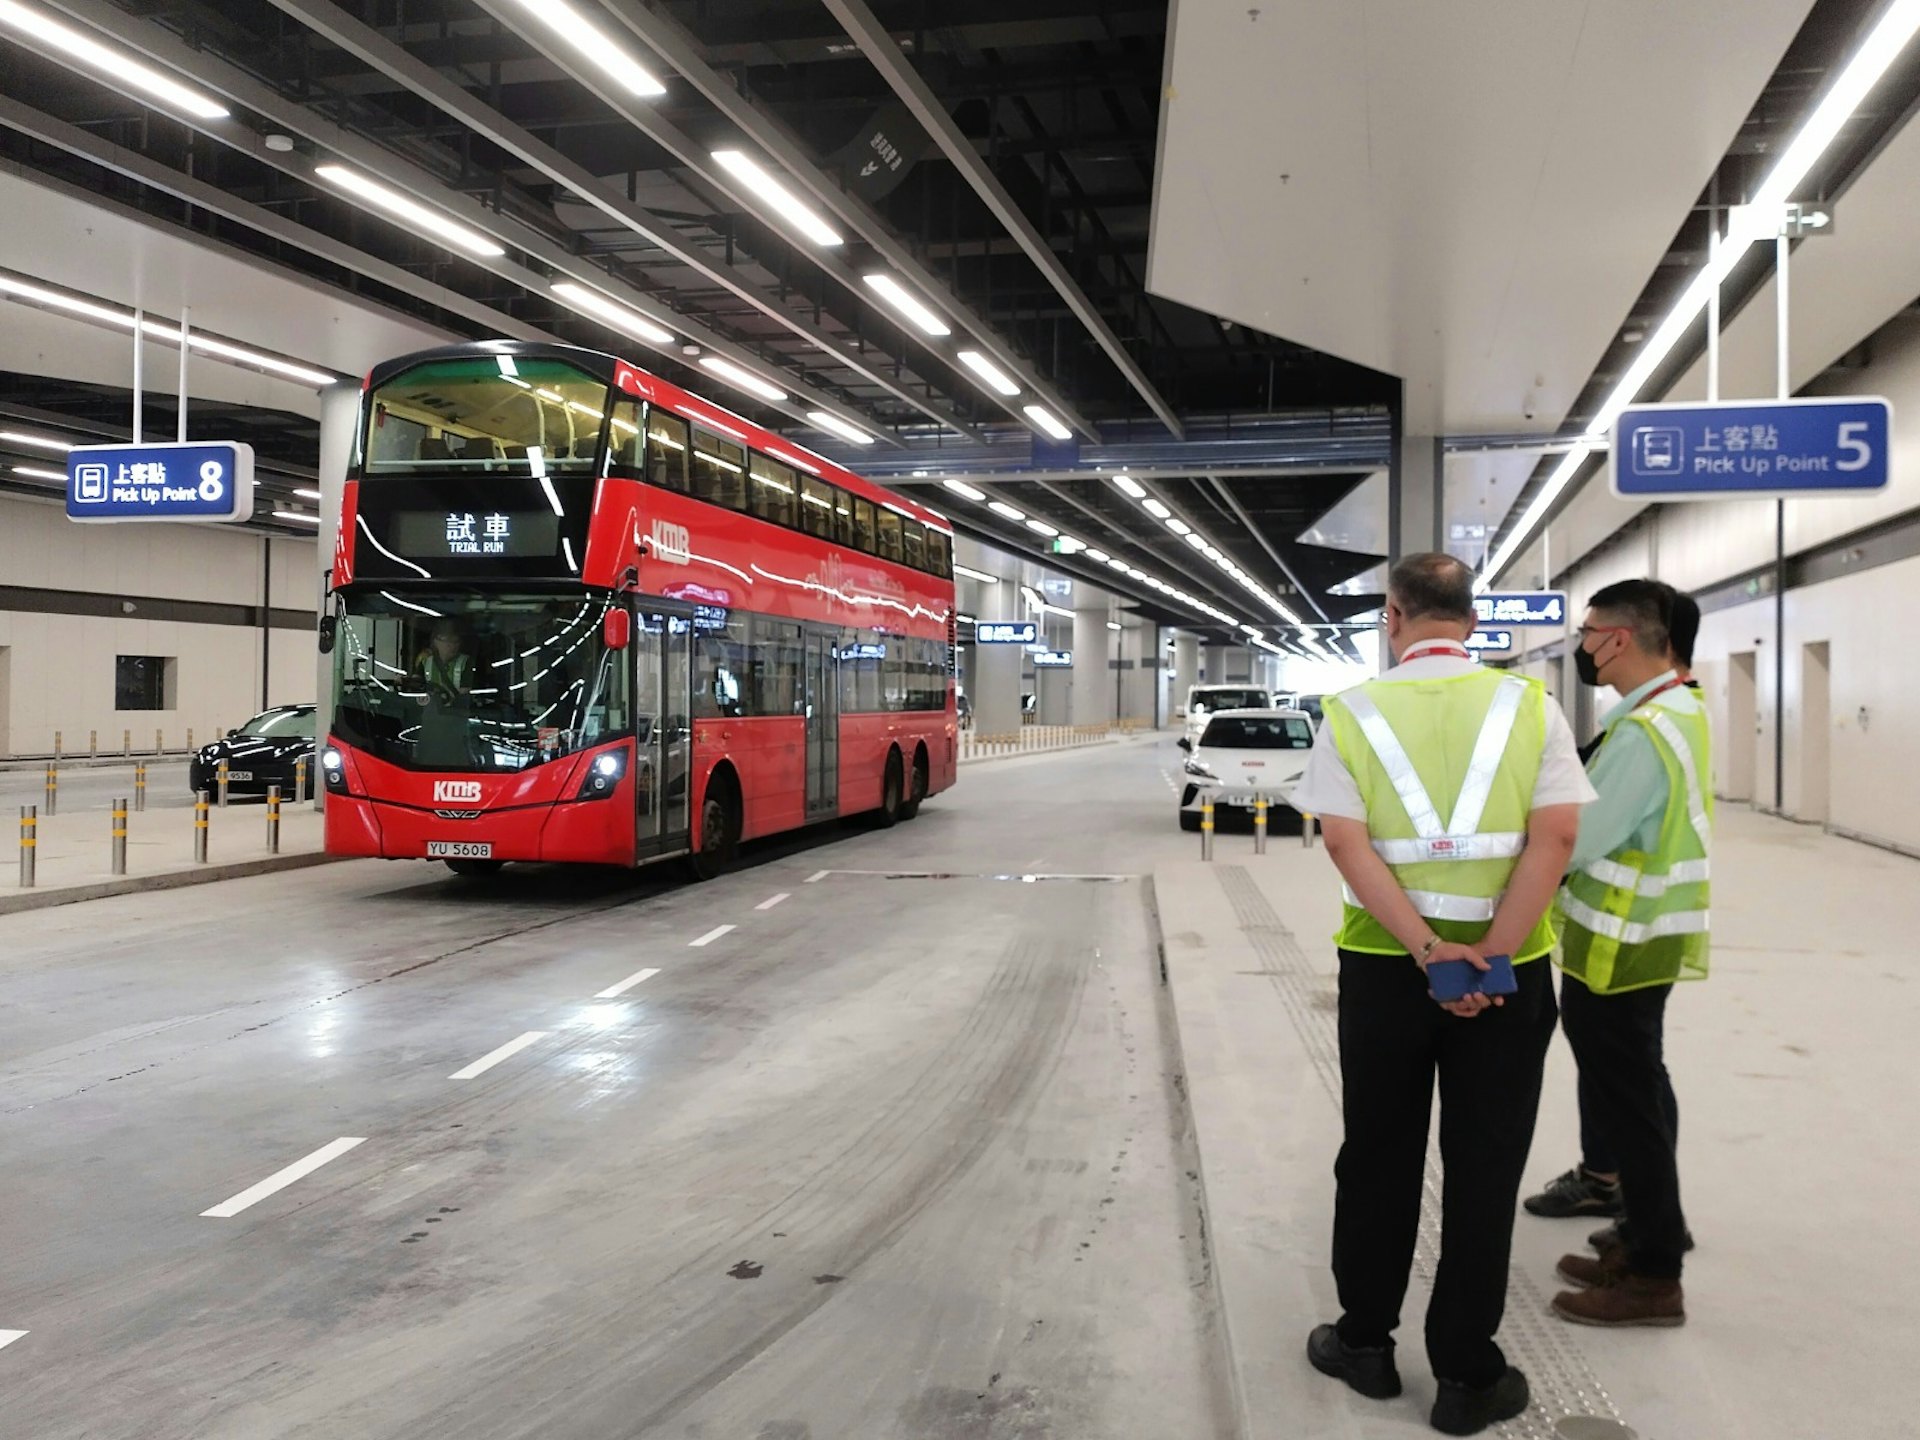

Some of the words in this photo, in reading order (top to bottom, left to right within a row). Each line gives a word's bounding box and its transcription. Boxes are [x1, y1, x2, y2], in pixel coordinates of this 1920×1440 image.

[1694, 456, 1735, 474] Pick
[1741, 456, 1770, 477] Up
[1776, 454, 1829, 472] Point
[1835, 421, 1872, 472] 5
[1695, 424, 1778, 452] 上客點
[113, 463, 166, 485] 上客點
[113, 487, 139, 502] Pick
[141, 488, 160, 505] Up
[163, 486, 197, 501] Point
[199, 461, 223, 501] 8
[446, 512, 510, 541] 試車
[449, 541, 481, 553] TRIAL
[483, 541, 504, 553] RUN
[652, 518, 690, 566] KMB
[433, 780, 482, 803] KMB
[430, 843, 448, 855] YU
[453, 844, 489, 857] 5608
